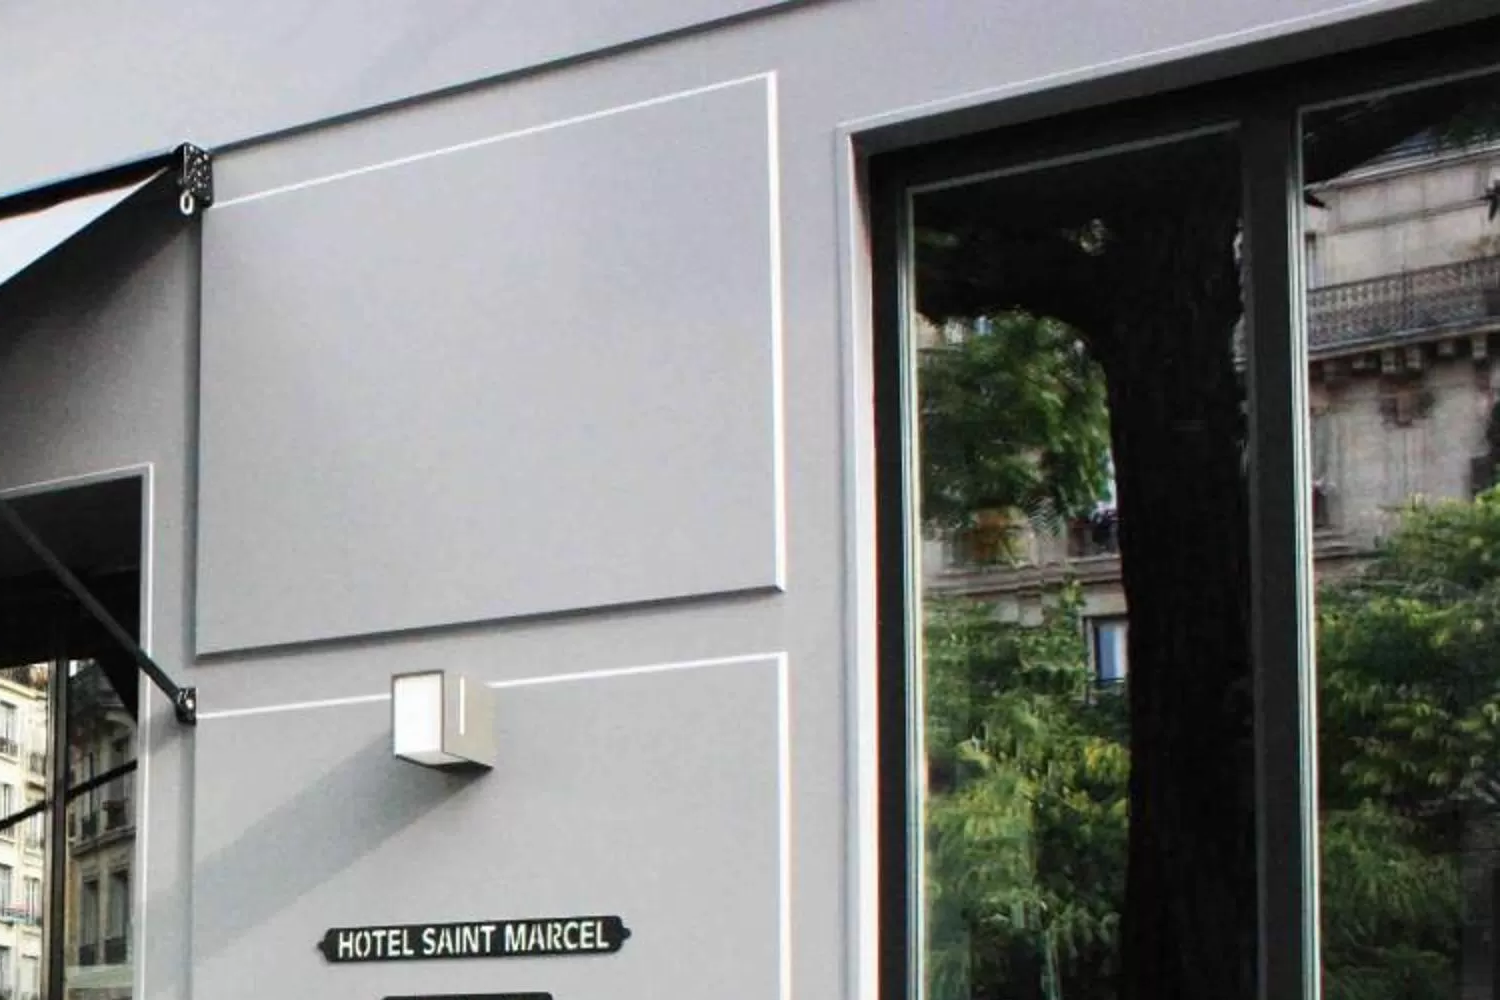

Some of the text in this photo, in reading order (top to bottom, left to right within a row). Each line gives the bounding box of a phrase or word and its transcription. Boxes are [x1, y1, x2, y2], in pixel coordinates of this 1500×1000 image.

[338, 920, 610, 959] HOTEL SAINT MARCEL
